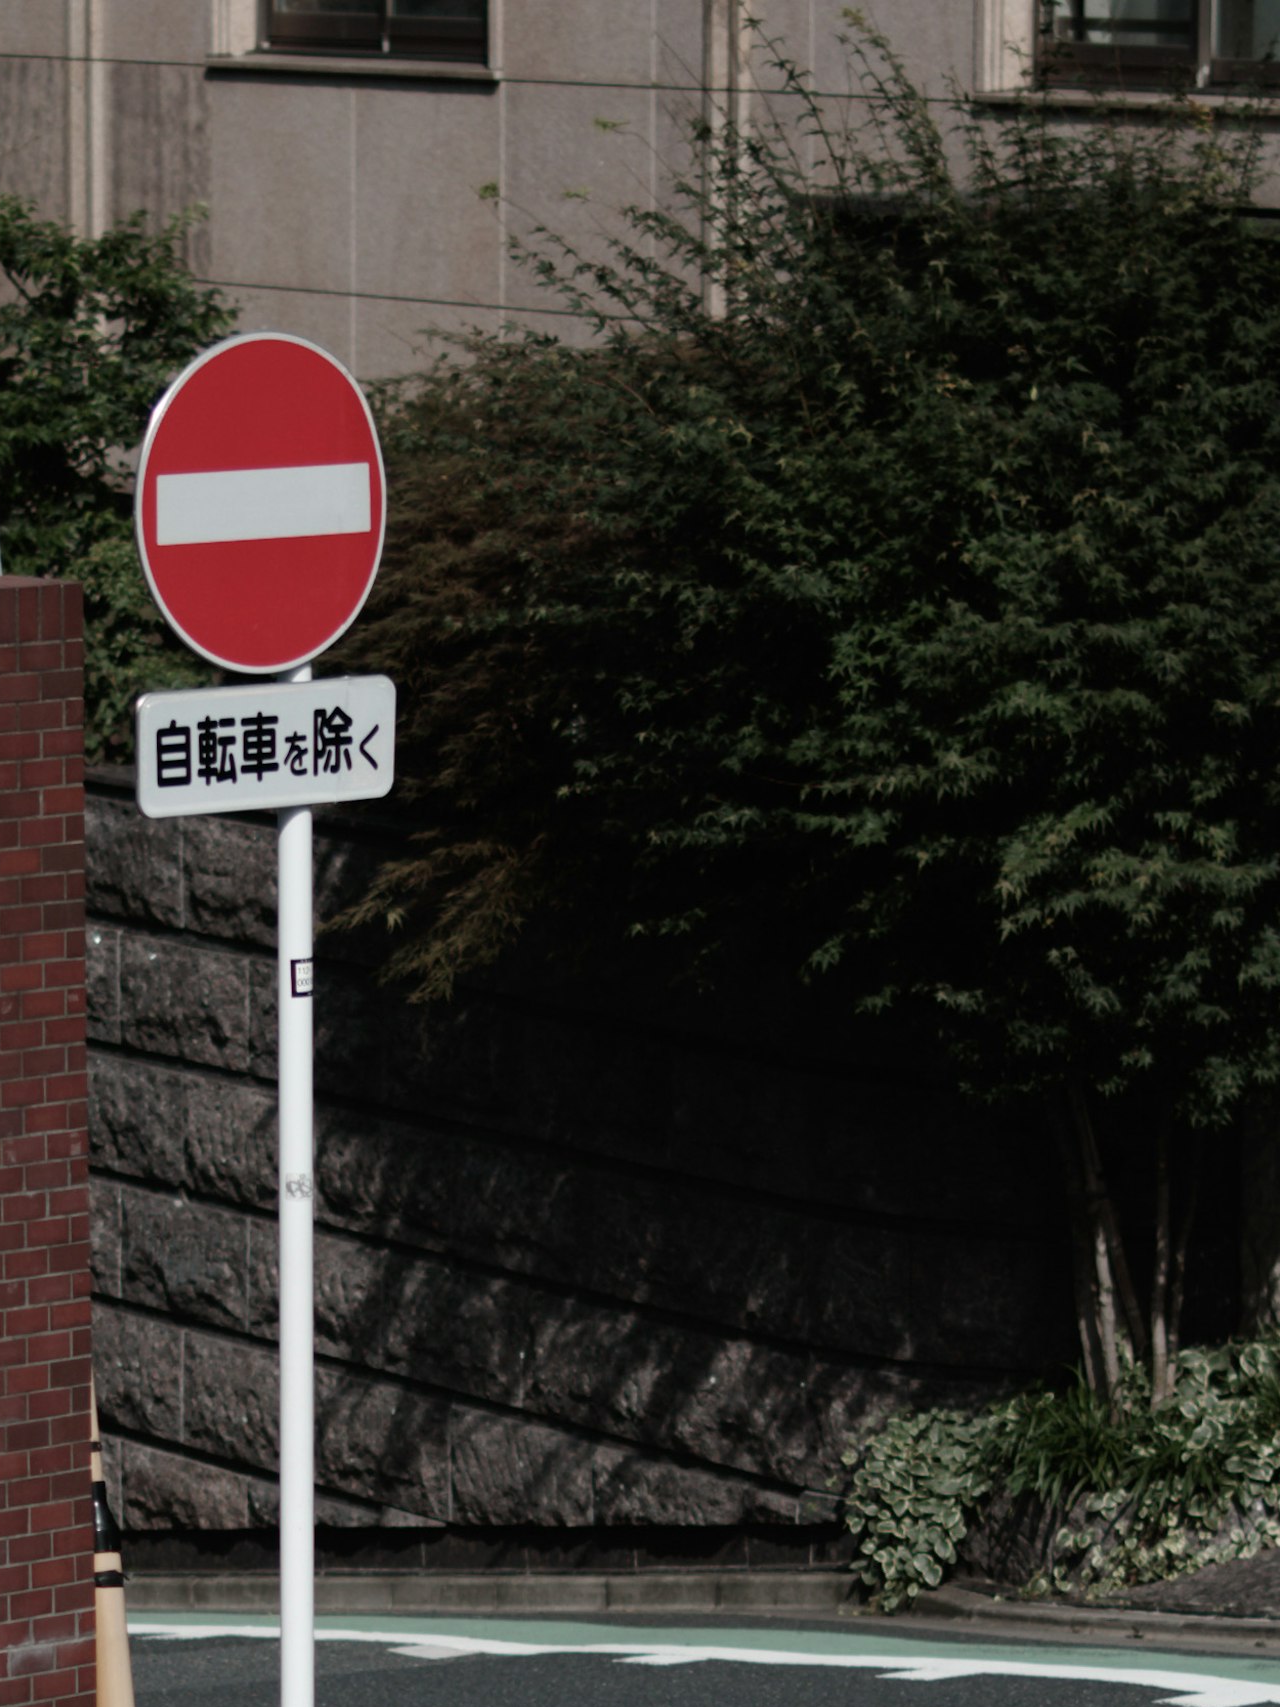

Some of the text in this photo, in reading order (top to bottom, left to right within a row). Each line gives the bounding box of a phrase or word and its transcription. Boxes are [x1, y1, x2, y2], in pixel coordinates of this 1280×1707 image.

[156, 706, 380, 788] 自転車を除く
